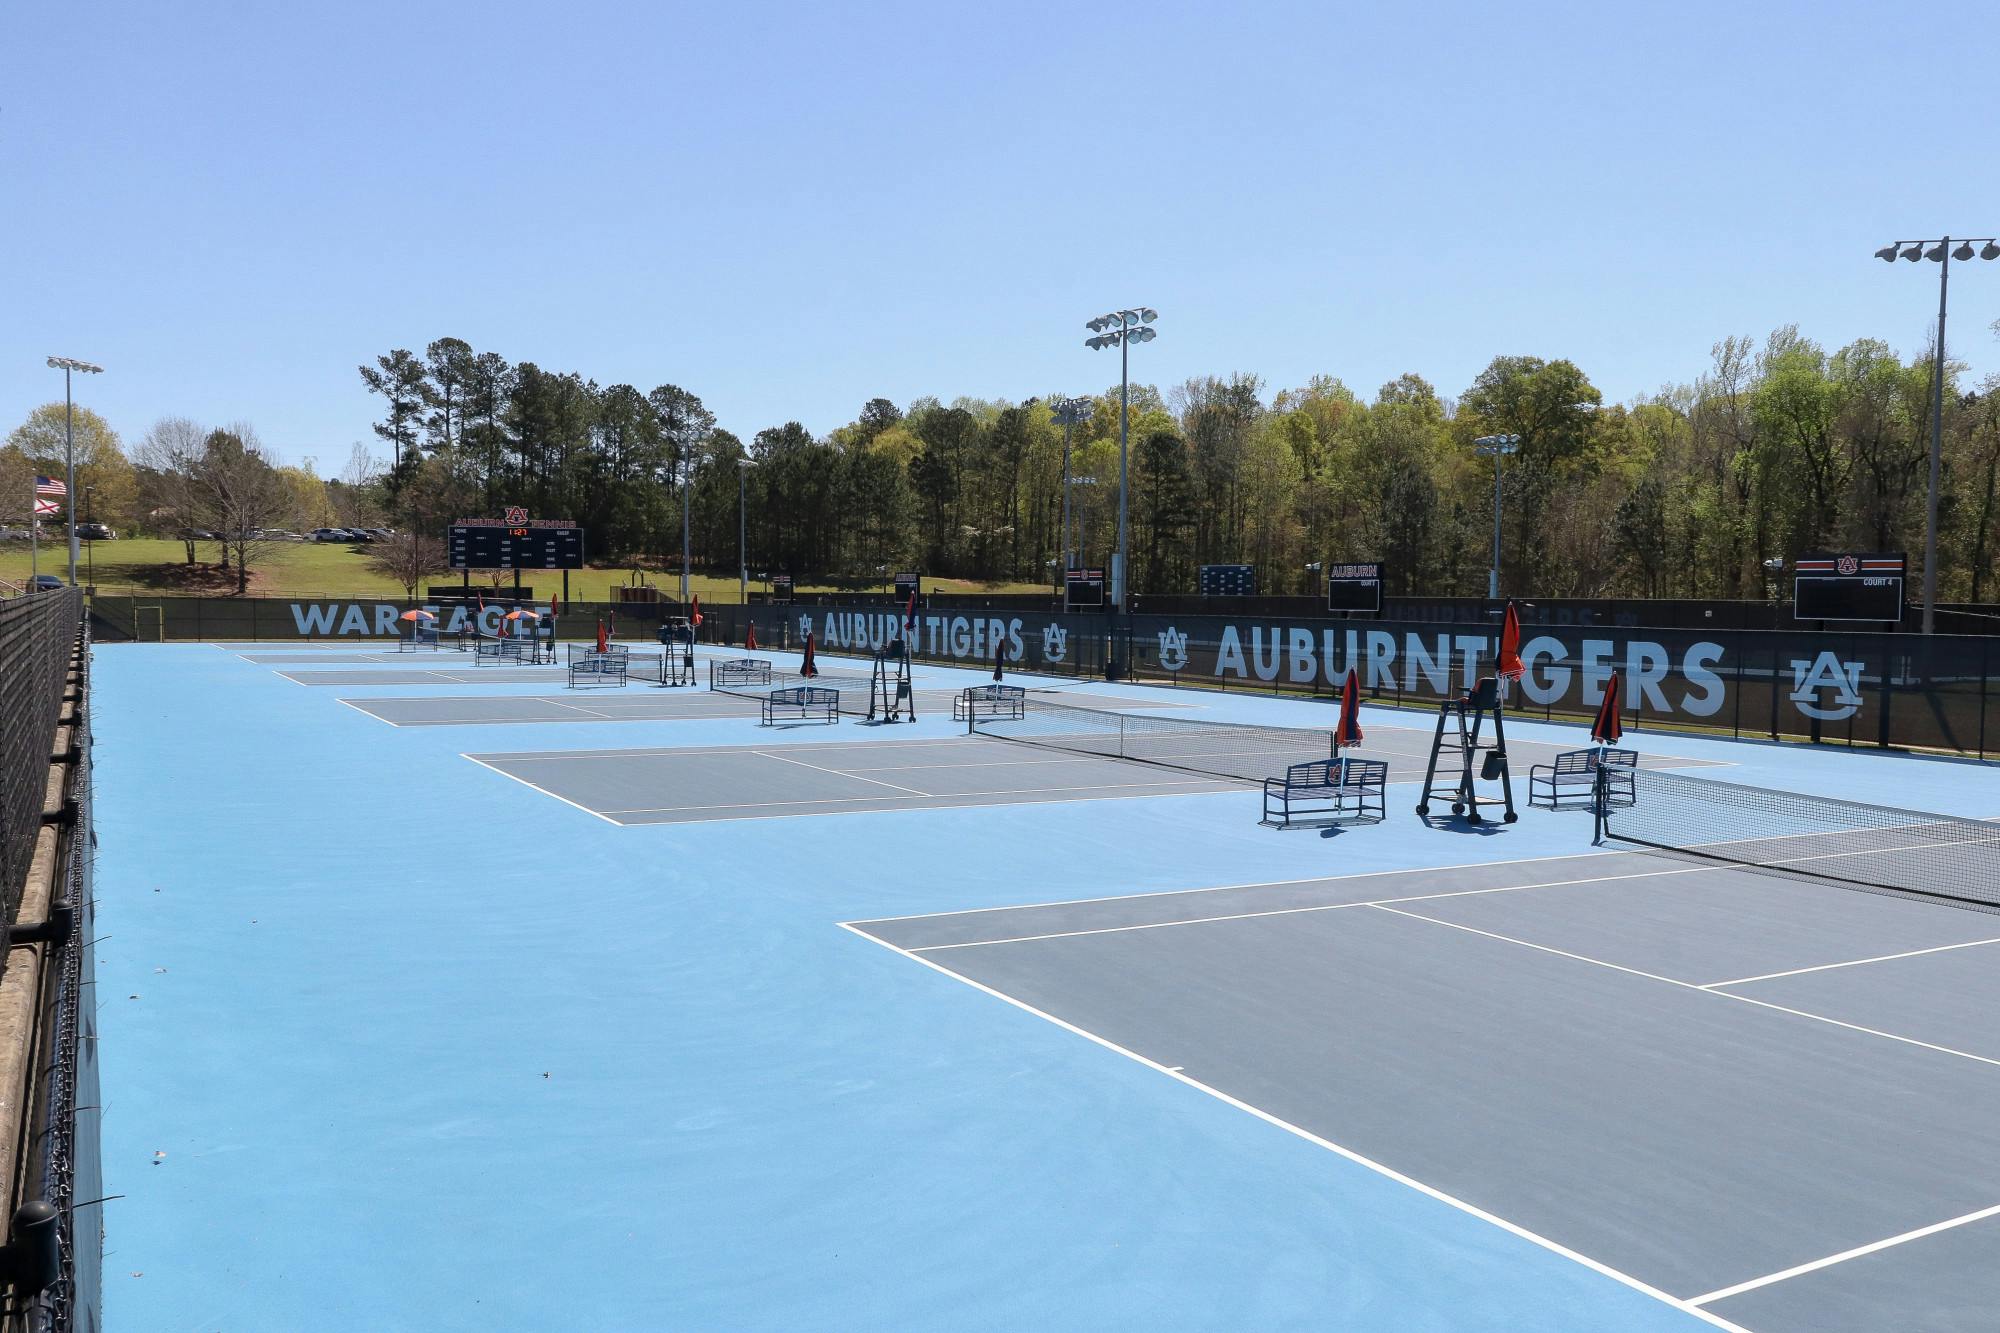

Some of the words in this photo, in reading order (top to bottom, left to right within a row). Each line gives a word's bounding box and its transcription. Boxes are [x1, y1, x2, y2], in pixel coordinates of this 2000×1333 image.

[1331, 565, 1377, 577] AUBURN
[1863, 578, 1886, 586] COURT
[1887, 578, 1893, 586] 4
[291, 604, 400, 635] WAR
[824, 612, 920, 652] AUBURN
[926, 616, 1024, 662] TIGERS
